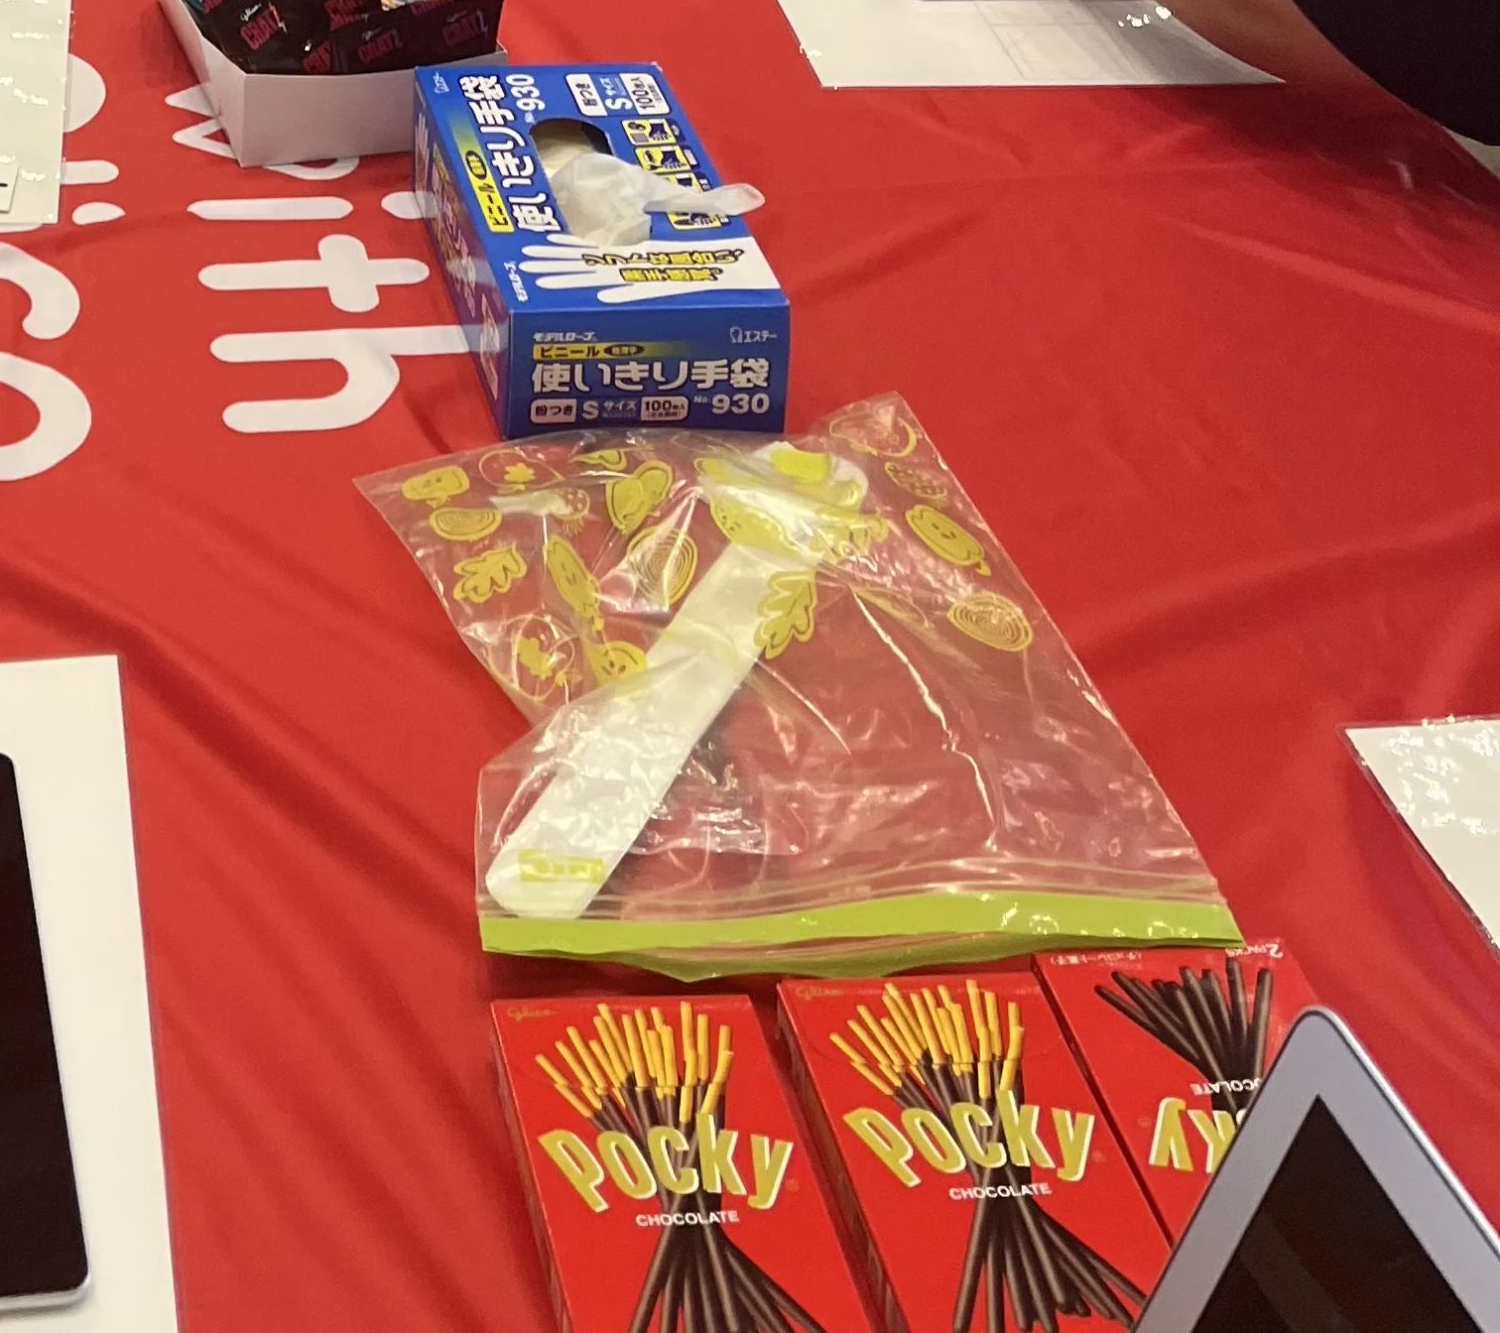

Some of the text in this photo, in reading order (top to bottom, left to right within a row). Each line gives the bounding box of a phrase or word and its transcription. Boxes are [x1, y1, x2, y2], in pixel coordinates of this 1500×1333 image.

[511, 73, 546, 112] 930
[459, 75, 562, 233] 使いきり手袋
[538, 344, 600, 359] ビニール
[531, 357, 770, 393] 使いきり手袋
[534, 403, 574, 418] 粉つき
[581, 400, 599, 420] S
[711, 392, 771, 416] 930
[949, 1182, 1053, 1201] CHOCOLATE
[636, 1209, 740, 1227] CHOCOLATE
